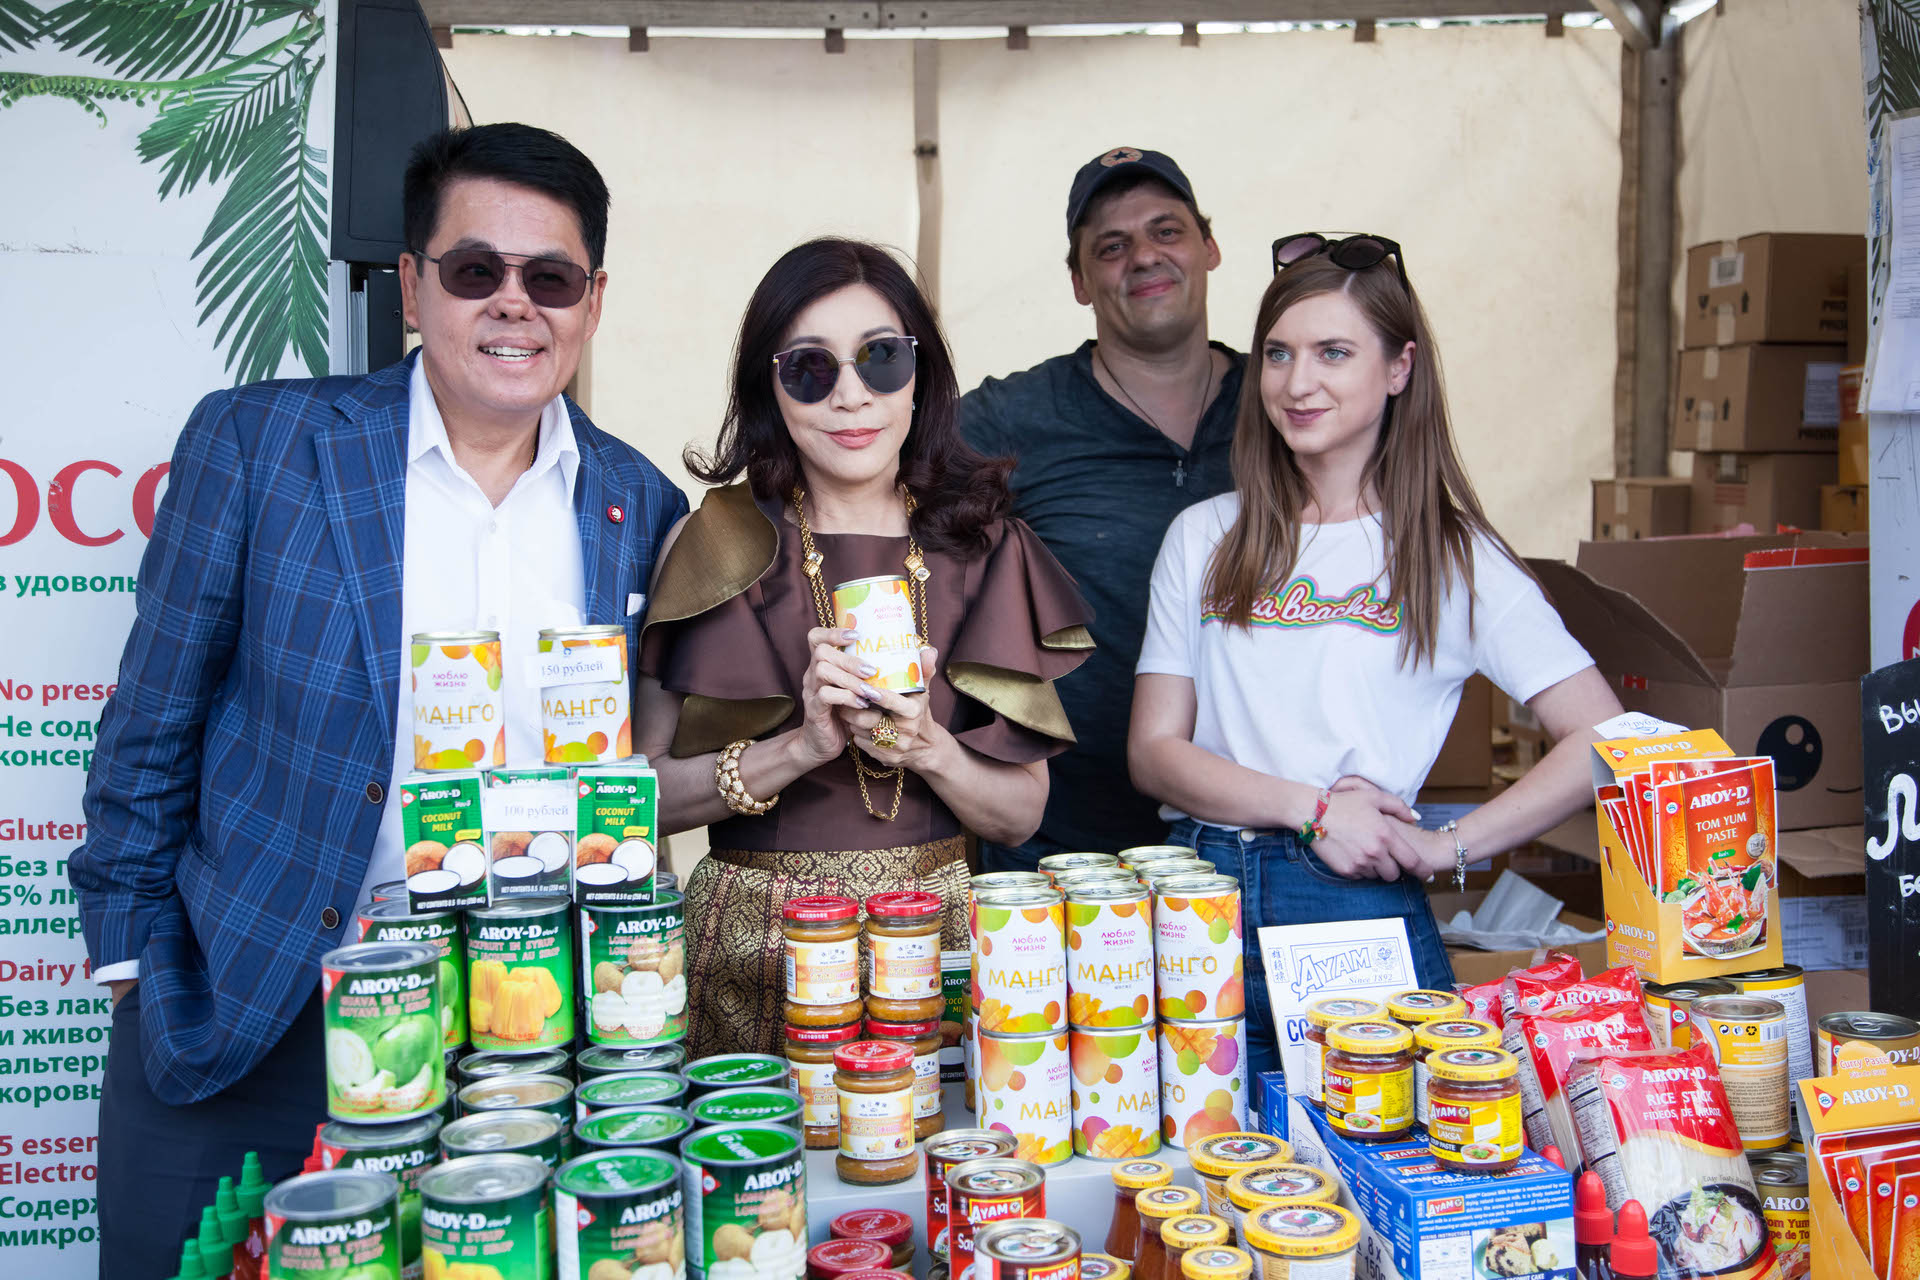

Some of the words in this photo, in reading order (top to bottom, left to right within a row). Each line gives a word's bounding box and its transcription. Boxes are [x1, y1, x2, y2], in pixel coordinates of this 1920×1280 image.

[1281, 584, 1396, 625] beaches
[562, 661, 603, 676] рублей
[0, 679, 34, 701] No
[415, 703, 494, 725] МАНГО
[542, 697, 617, 718] МАНГО
[0, 716, 32, 737] Не
[1633, 741, 1692, 756] AROY-D
[420, 789, 461, 800] AROY-D
[596, 784, 637, 794] AROY-D
[1690, 786, 1748, 810] AROY-D
[422, 812, 461, 823] COCONUT
[504, 806, 523, 816] 100
[527, 806, 569, 818] рублей
[596, 808, 635, 816] COCONUT
[432, 823, 453, 832] MILK
[605, 818, 626, 826] MILK
[1696, 818, 1721, 832] TOM
[1723, 812, 1747, 826] YUM
[1706, 828, 1738, 844] PASTE
[0, 856, 48, 877] Без
[0, 885, 42, 905] 5%
[377, 924, 442, 940] AROY-D
[479, 925, 542, 940] AROY-D
[616, 916, 675, 934] AROY-D
[1158, 922, 1187, 932] люблю
[1618, 923, 1656, 942] AROY-D
[1012, 935, 1047, 944] люблю
[1101, 929, 1136, 939] люблю
[1104, 938, 1134, 946] жизнь
[1161, 930, 1185, 939] жизнь
[526, 937, 555, 949] SYRUP
[1614, 941, 1629, 956] Curry
[1633, 946, 1651, 960] Paste
[1078, 957, 1152, 982] МАНГО
[1157, 953, 1218, 975] АНГО
[0, 960, 75, 987] Dairy
[989, 964, 1064, 988] МАНГО
[1291, 947, 1371, 1002] AYAM
[1349, 976, 1370, 984] Since
[1374, 973, 1393, 981] 1892
[349, 974, 421, 995] AROY-D
[0, 995, 49, 1018] Без
[56, 997, 113, 1016] лак
[1554, 990, 1621, 1006] AROY-D
[0, 1029, 14, 1046] и
[1840, 1060, 1862, 1069] Curry
[1864, 1056, 1890, 1066] Paste
[1886, 1046, 1920, 1064] OY-D
[1642, 1066, 1707, 1084] AROY-D
[1646, 1092, 1676, 1106] RICE
[1681, 1091, 1714, 1103] STICK
[1843, 1084, 1909, 1105] AROY-D
[1020, 1095, 1072, 1121] МАН
[1430, 1104, 1456, 1120] AYAM
[1643, 1109, 1676, 1120] FIDEOS
[1680, 1108, 1694, 1117] DE
[1437, 1130, 1461, 1141] LAKSA
[0, 1136, 13, 1156] 5
[1440, 1142, 1456, 1151] PASTE
[352, 1151, 424, 1172] AROY-D
[1384, 1150, 1415, 1160] AYAM
[0, 1162, 97, 1184] Electro
[744, 1160, 802, 1191] AROY-D
[1509, 1164, 1541, 1176] AYAM
[620, 1190, 682, 1225] AROY-D
[968, 1203, 1008, 1225] AYAM
[1426, 1200, 1454, 1218] AYAM
[1766, 1218, 1784, 1228] om
[291, 1219, 372, 1245] AROY-D
[1785, 1230, 1796, 1239] de
[1368, 1236, 1374, 1249] 8
